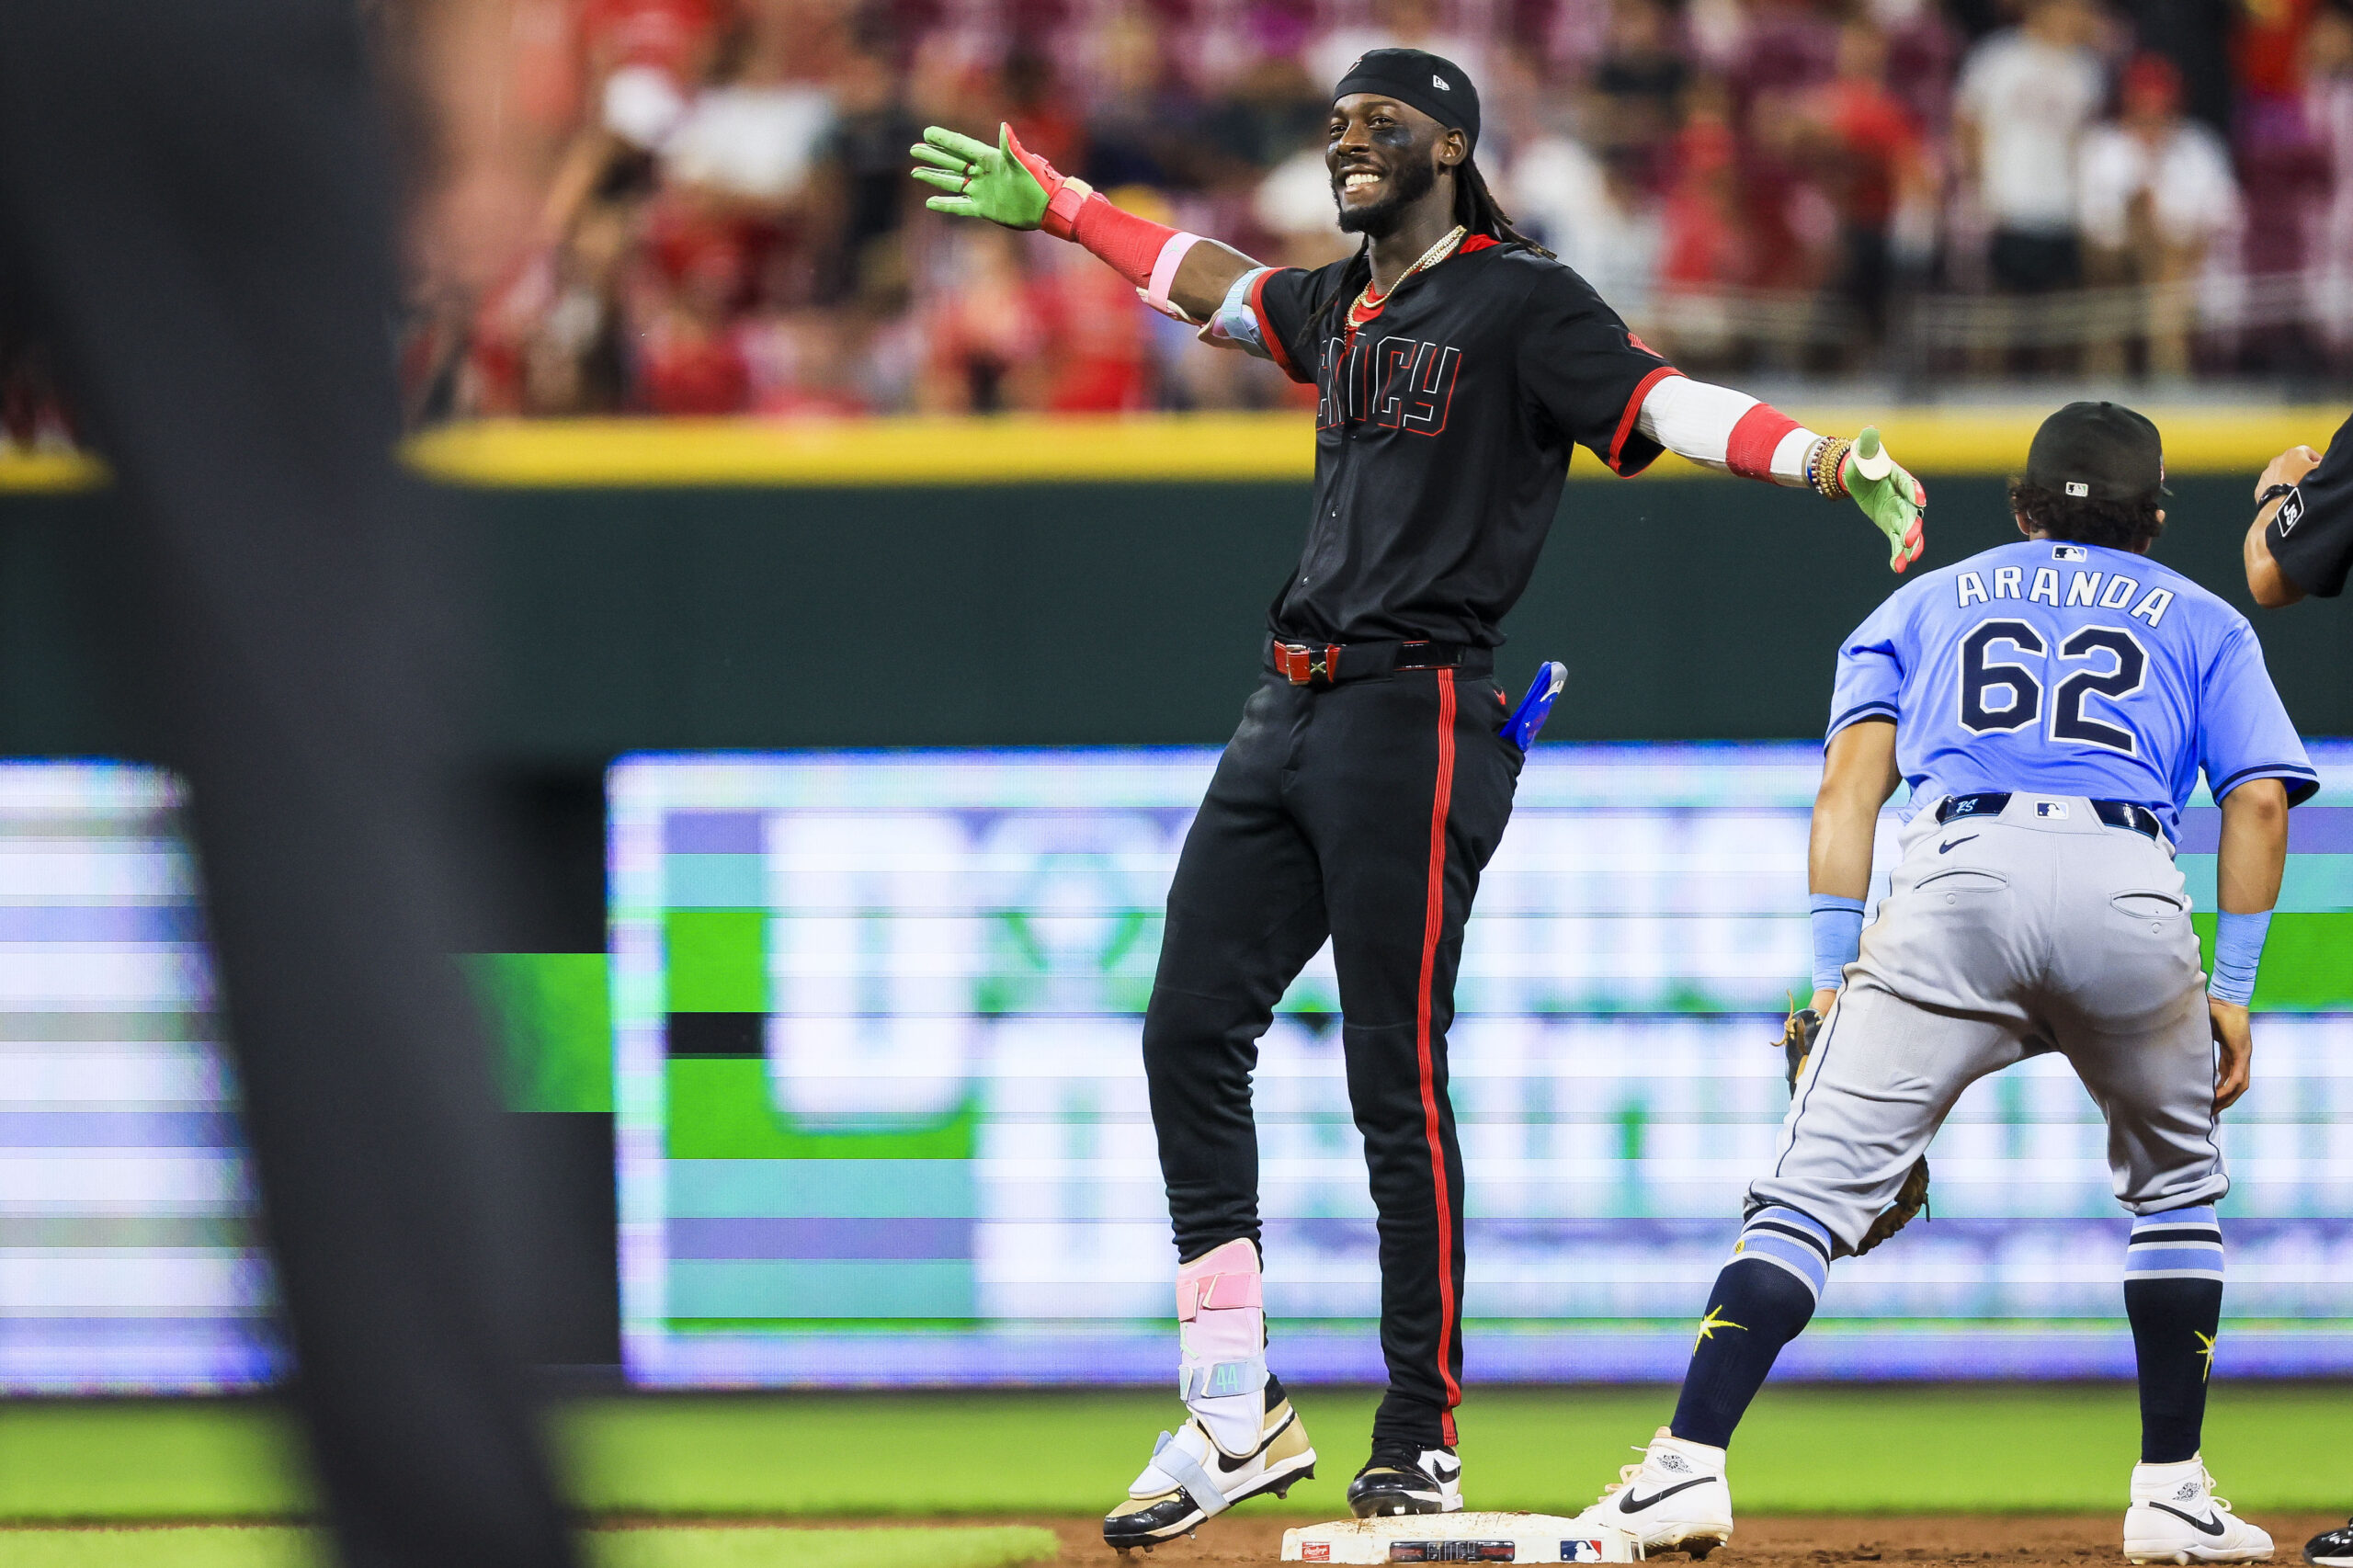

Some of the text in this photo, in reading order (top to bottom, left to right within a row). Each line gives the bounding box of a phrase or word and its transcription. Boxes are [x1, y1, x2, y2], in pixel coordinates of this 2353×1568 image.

[1956, 565, 2176, 629] ARANDA
[1957, 618, 2150, 757] 62
[1216, 1364, 1239, 1392] 44
